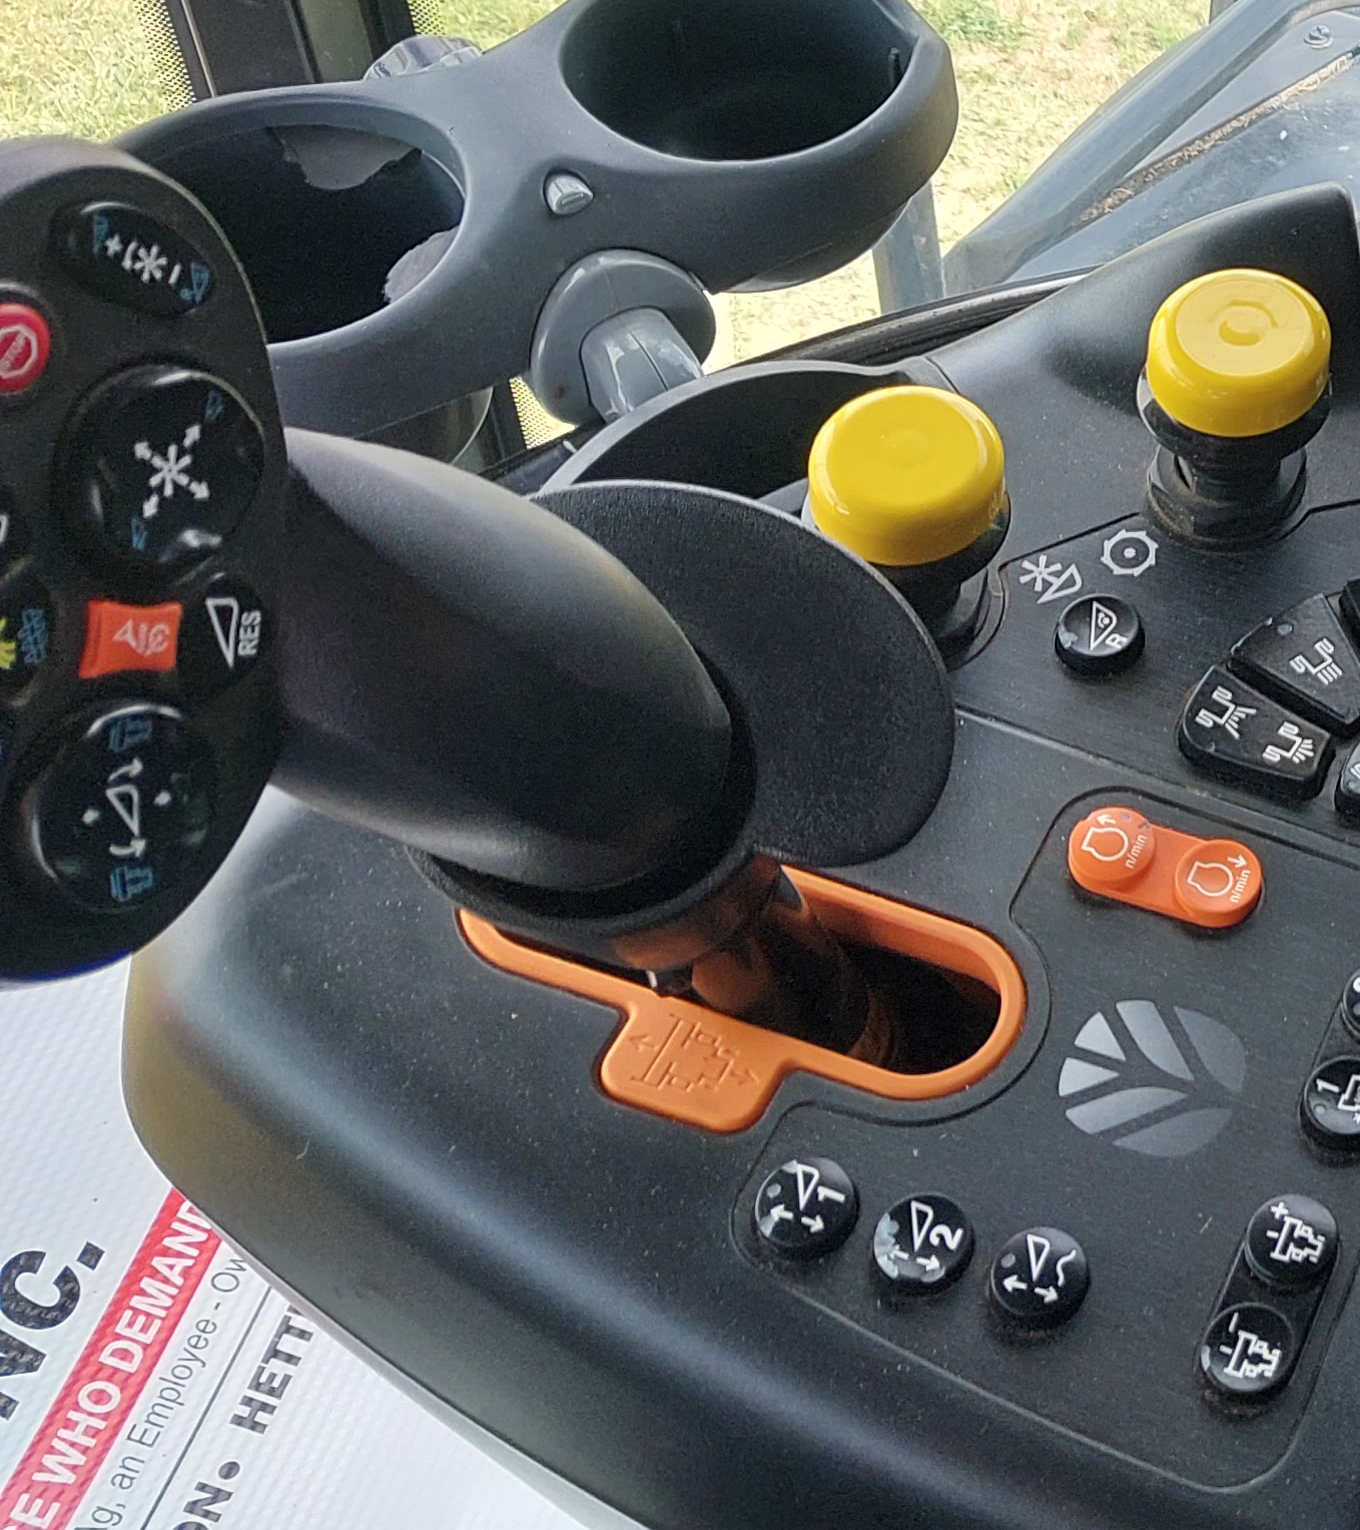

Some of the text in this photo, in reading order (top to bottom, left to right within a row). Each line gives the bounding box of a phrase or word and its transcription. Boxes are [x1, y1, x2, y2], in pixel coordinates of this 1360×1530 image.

[237, 610, 262, 657] RES
[1105, 633, 1128, 649] R
[1125, 834, 1147, 869] n/min
[1229, 869, 1251, 903] n/min
[1316, 1078, 1339, 1093] 1
[817, 1185, 846, 1203] 1
[929, 1223, 964, 1251] 2
[126, 1317, 217, 1448] Employee
[229, 1304, 314, 1436] HETT
[32, 1381, 121, 1485] WHO
[111, 1456, 145, 1490] an
[74, 1503, 126, 1530] g,
